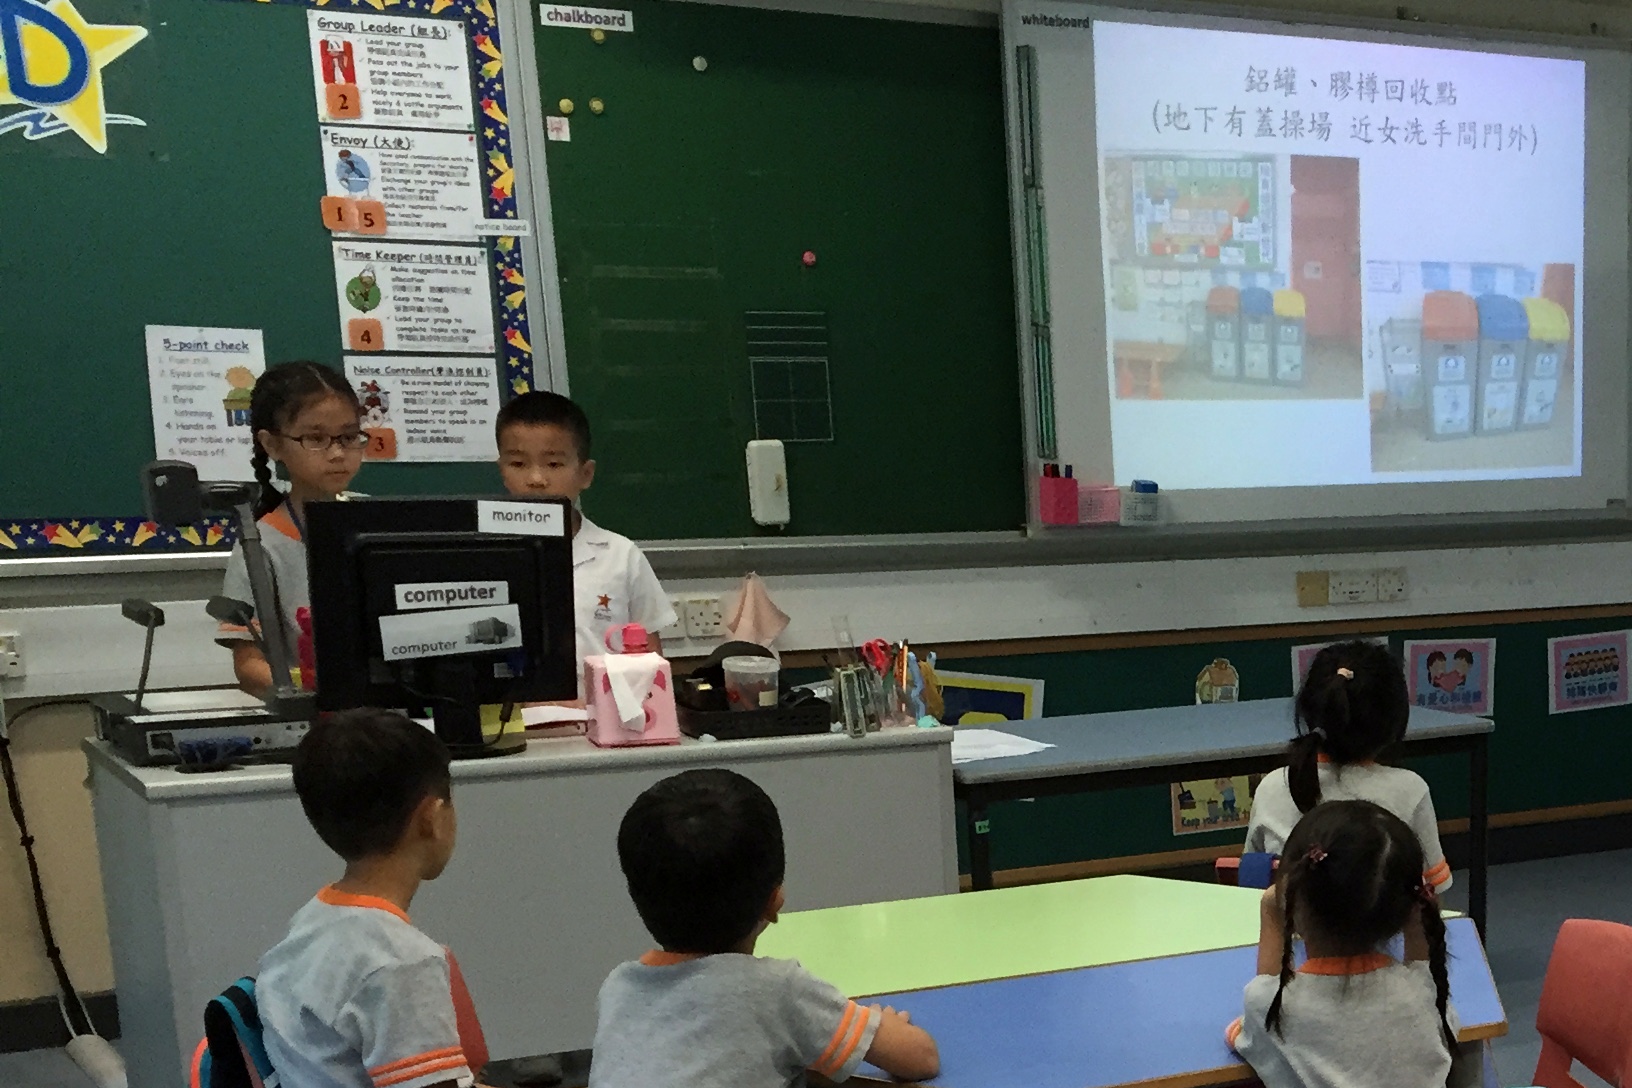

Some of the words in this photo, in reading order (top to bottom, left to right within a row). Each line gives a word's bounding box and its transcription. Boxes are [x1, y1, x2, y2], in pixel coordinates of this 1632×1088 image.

[546, 8, 626, 26] chalkboard
[1022, 14, 1089, 28] whiteboard
[318, 17, 355, 33] Group
[361, 20, 405, 34] Leader
[386, 40, 401, 48] your
[405, 41, 424, 49] group
[401, 60, 412, 68] the
[392, 70, 423, 78] members
[1245, 65, 1457, 106] 鋁罐、膠樽回收點
[338, 94, 349, 111] 2
[1153, 99, 1333, 142] (地下有蓋操場
[1350, 115, 1537, 155] 近女洗手間門外)
[331, 133, 368, 148] Envoy
[336, 206, 343, 222] 1
[364, 212, 375, 228] 5
[503, 223, 526, 231] board
[342, 248, 371, 260] Time
[376, 250, 416, 263] Keeper
[360, 329, 371, 344] 4
[163, 338, 208, 351] 5-point
[214, 340, 248, 351] check
[170, 370, 191, 378] Eyes
[354, 366, 380, 376] Noise
[374, 437, 385, 452] 3
[492, 508, 550, 523] monitor
[404, 585, 496, 604] computer
[392, 640, 458, 655] computer
[1181, 816, 1200, 829] Keep
